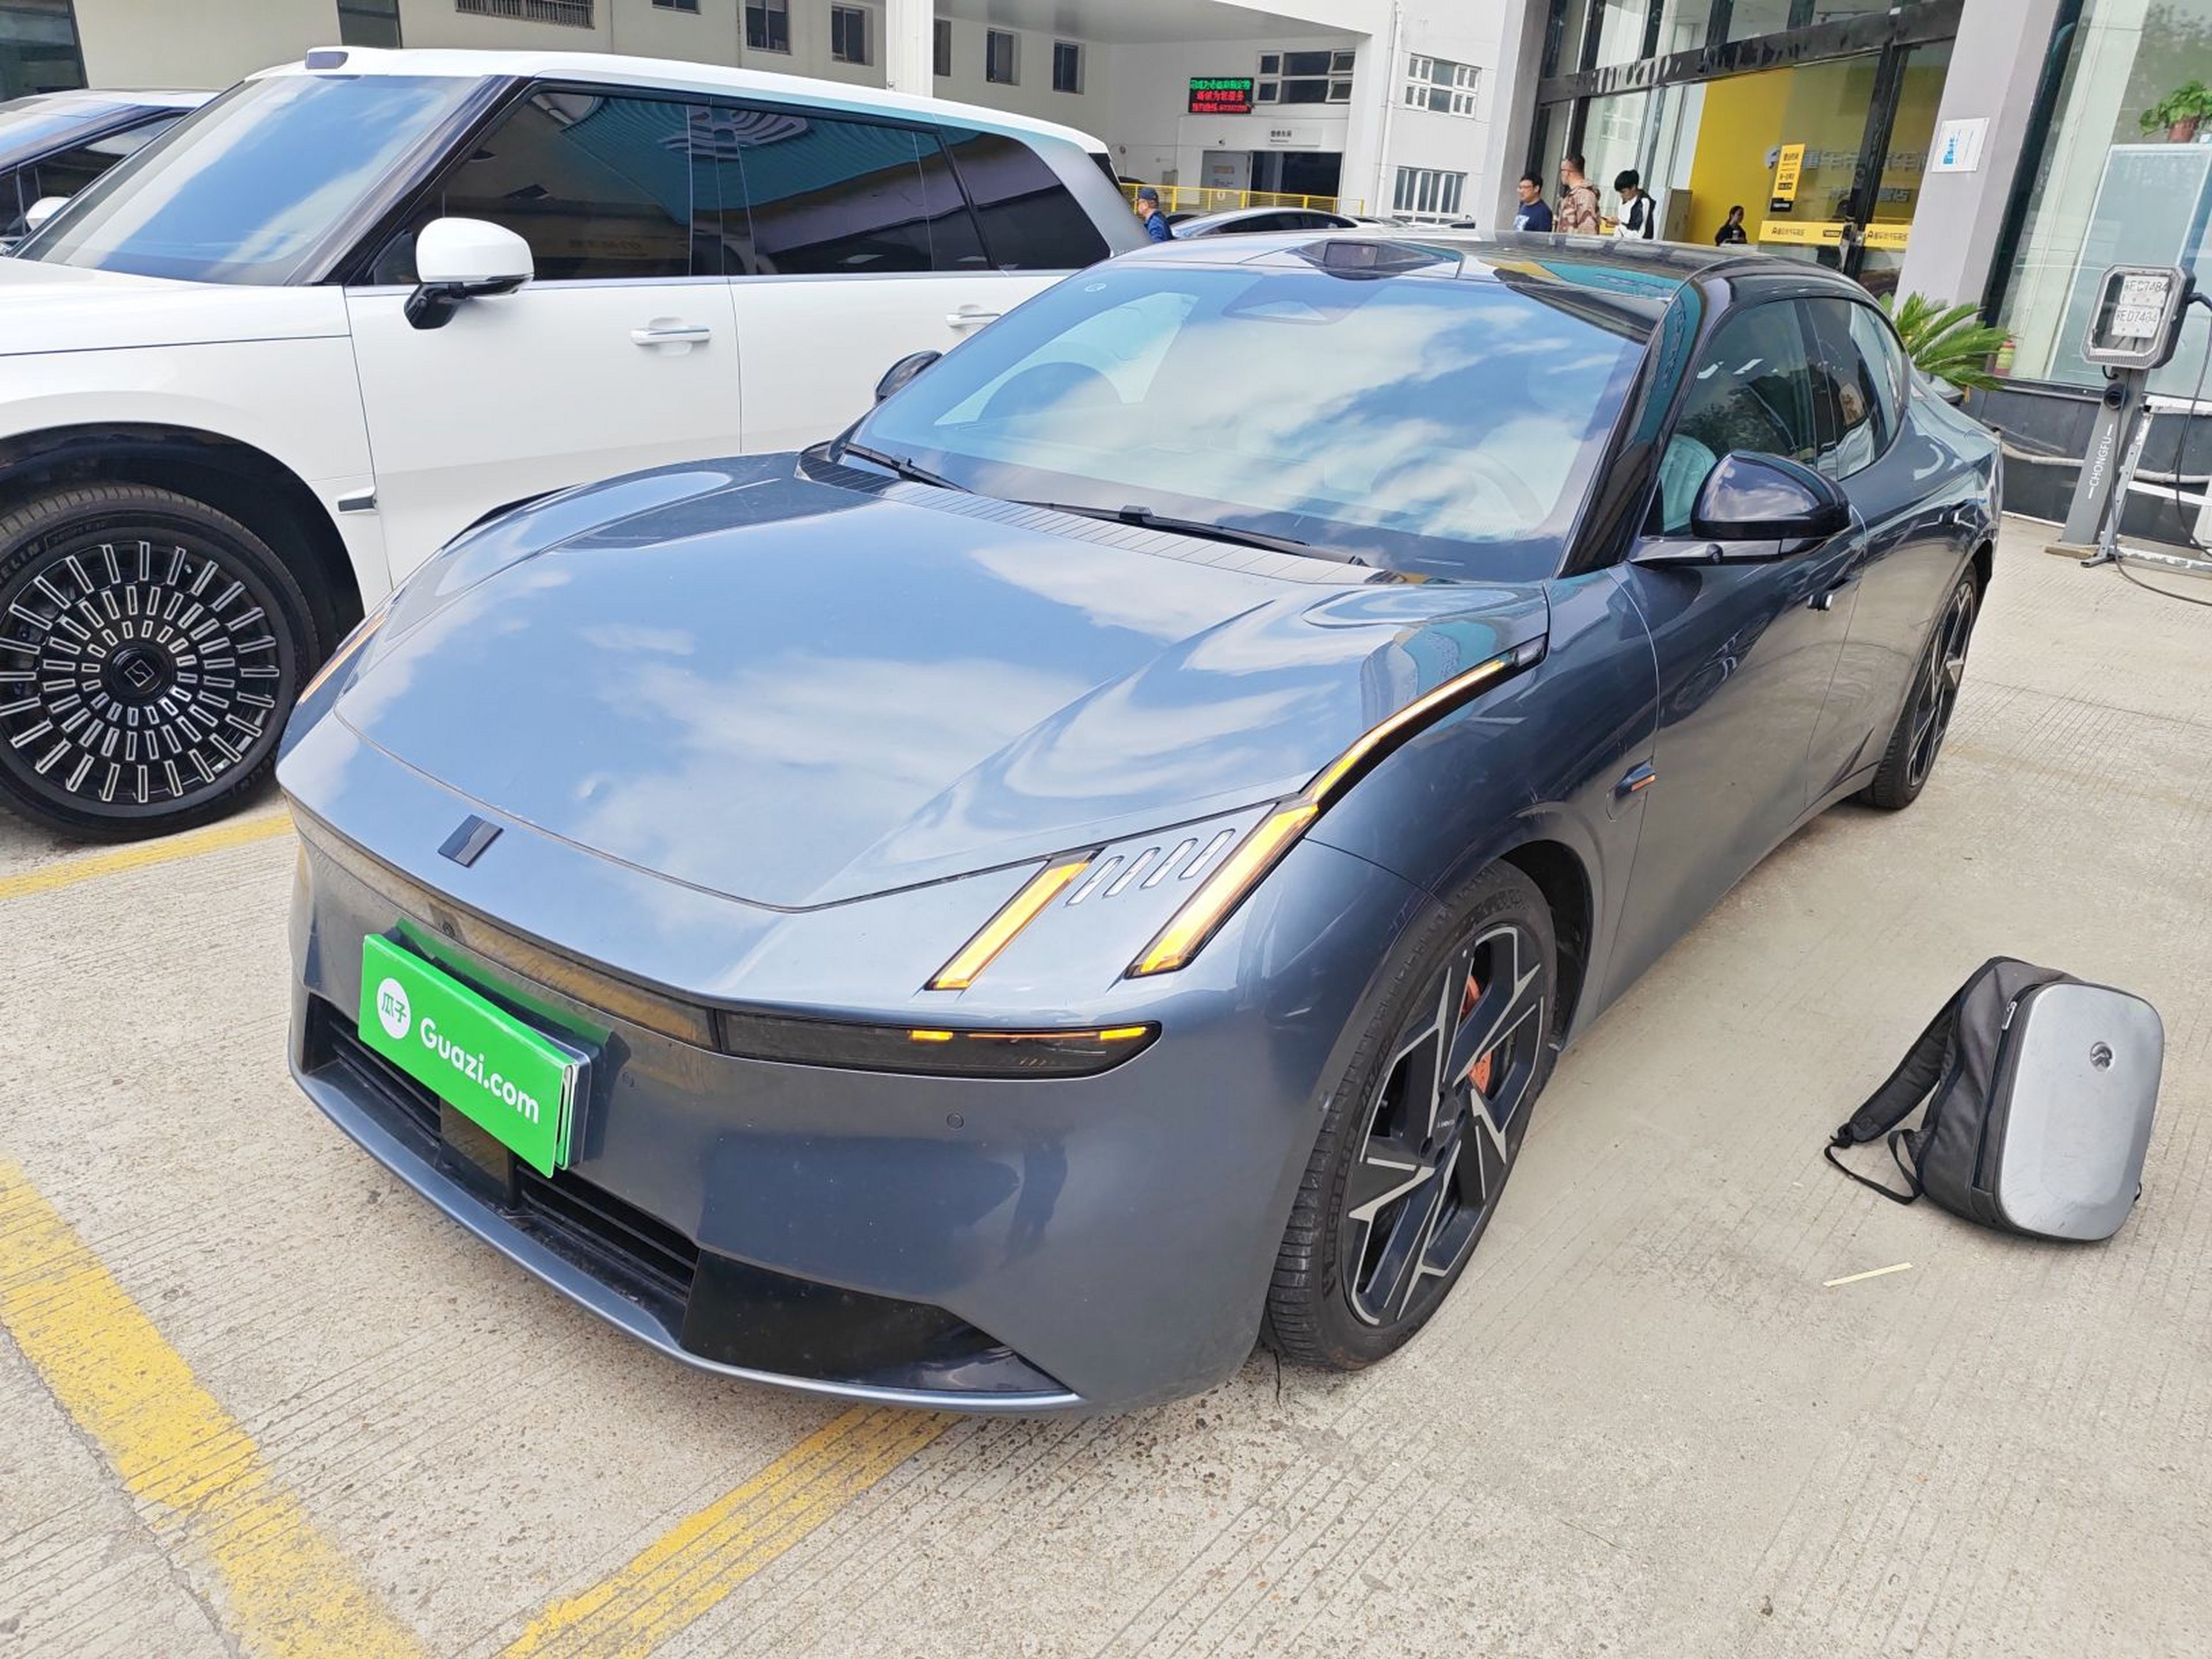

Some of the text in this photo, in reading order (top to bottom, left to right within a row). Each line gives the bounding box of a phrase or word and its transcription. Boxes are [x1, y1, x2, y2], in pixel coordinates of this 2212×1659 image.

[2089, 436, 2112, 486] CHONGFU
[382, 991, 407, 1023] 瓜子
[420, 1017, 539, 1124] Guazi.com
